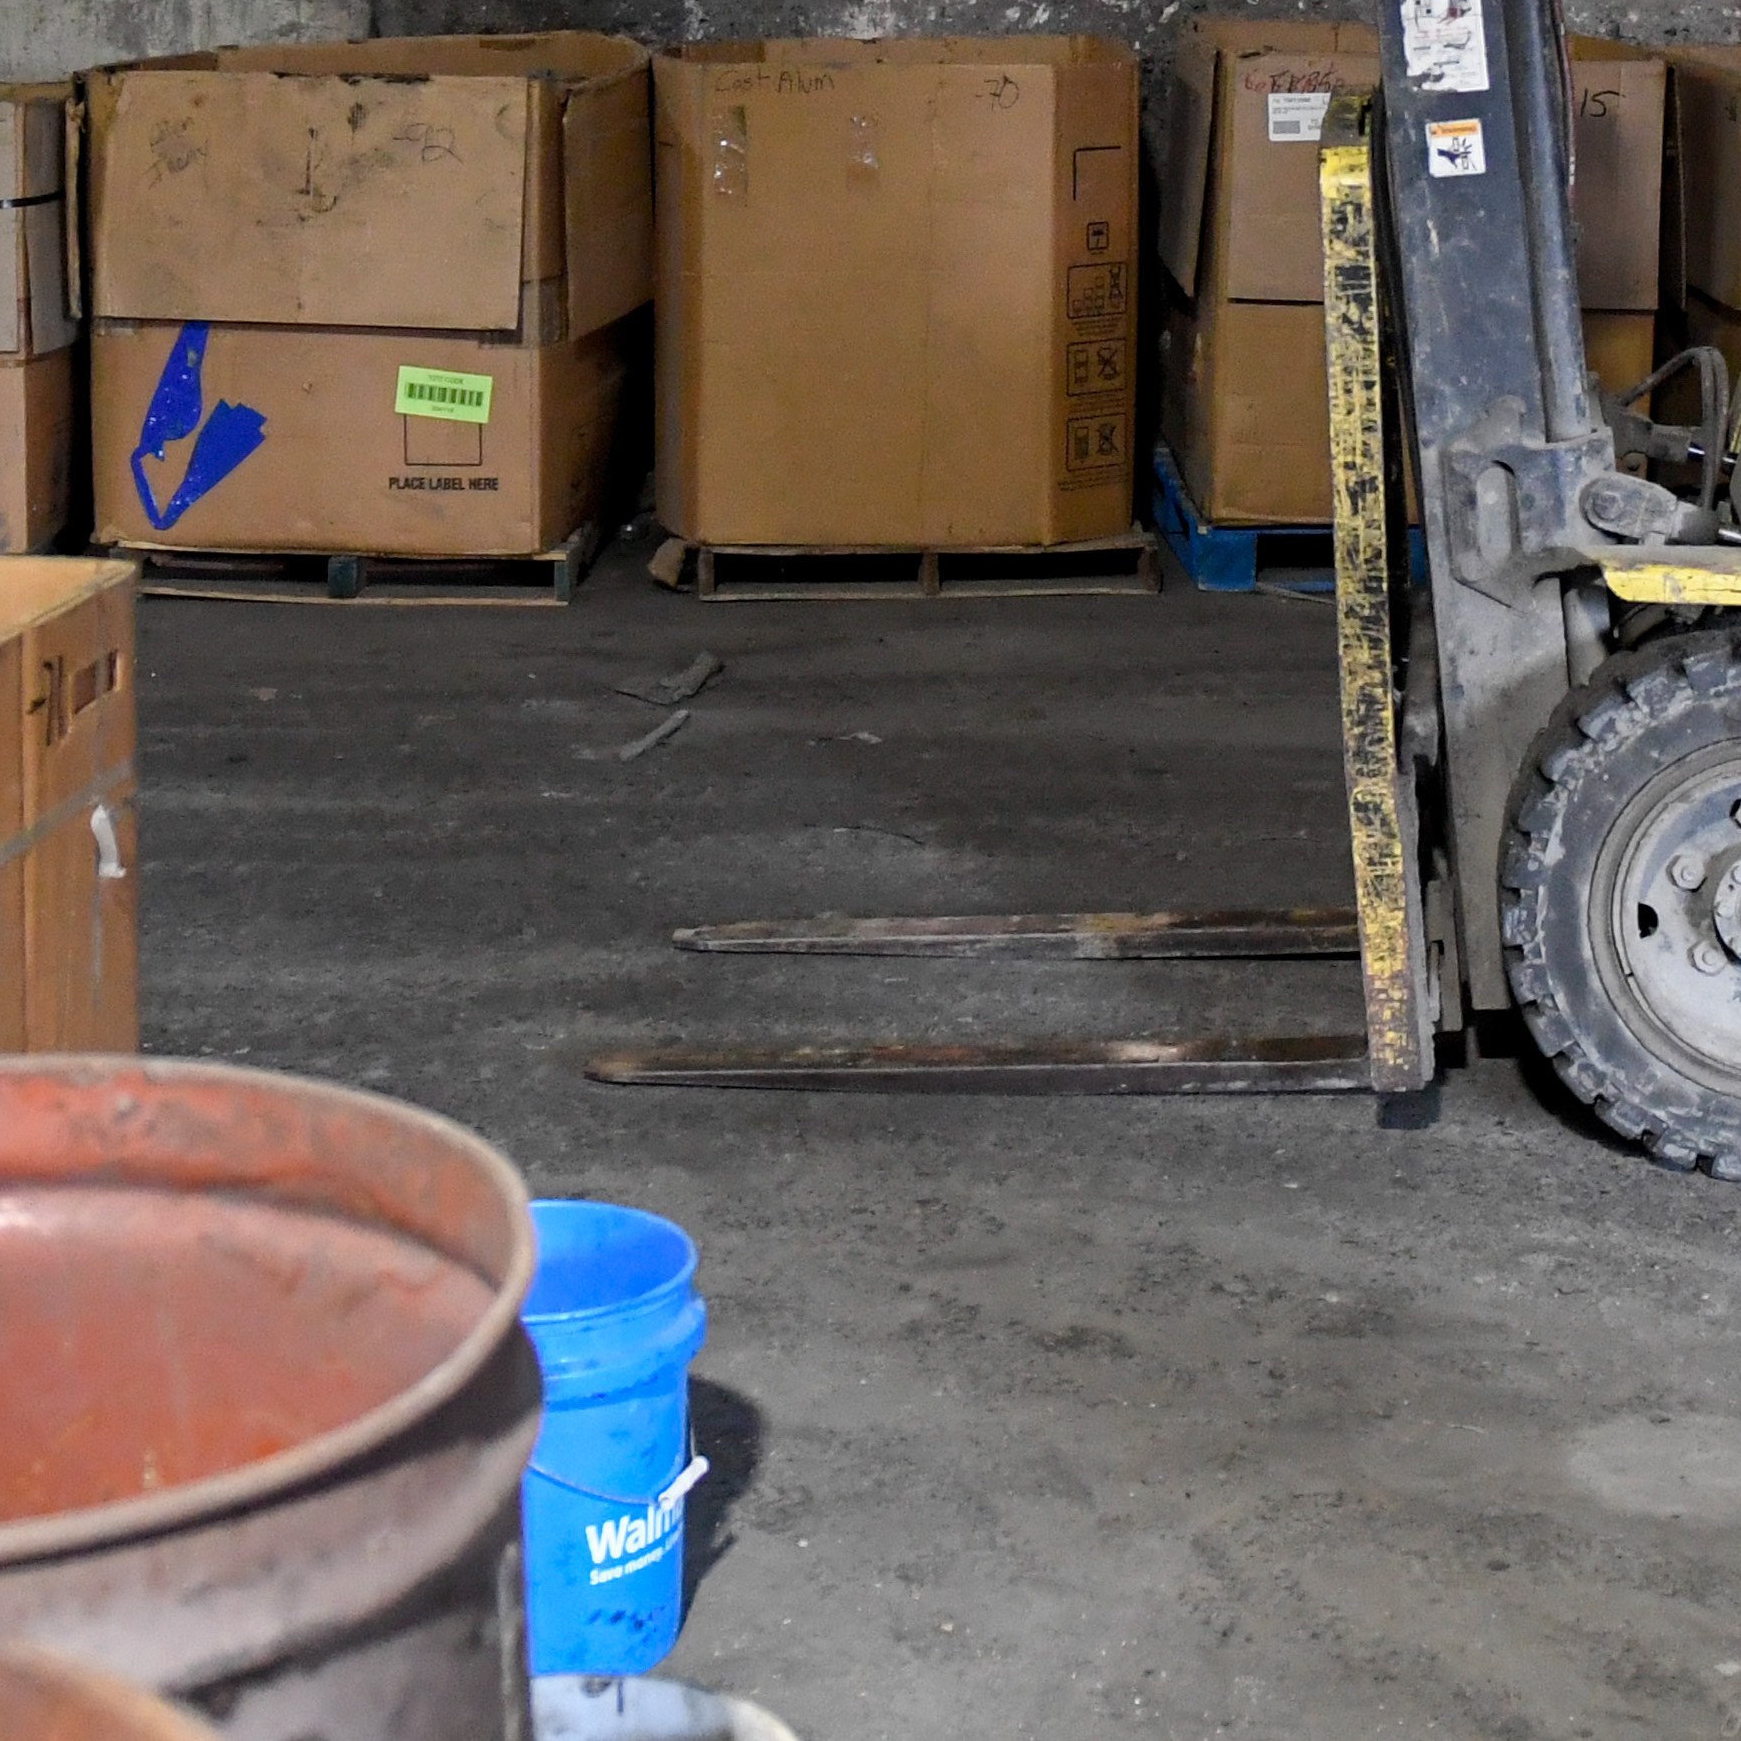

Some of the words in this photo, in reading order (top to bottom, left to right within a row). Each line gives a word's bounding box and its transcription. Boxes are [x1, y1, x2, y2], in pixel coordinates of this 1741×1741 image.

[388, 477, 426, 490] PLACE
[429, 478, 465, 490] LABEL
[468, 478, 499, 491] HERE
